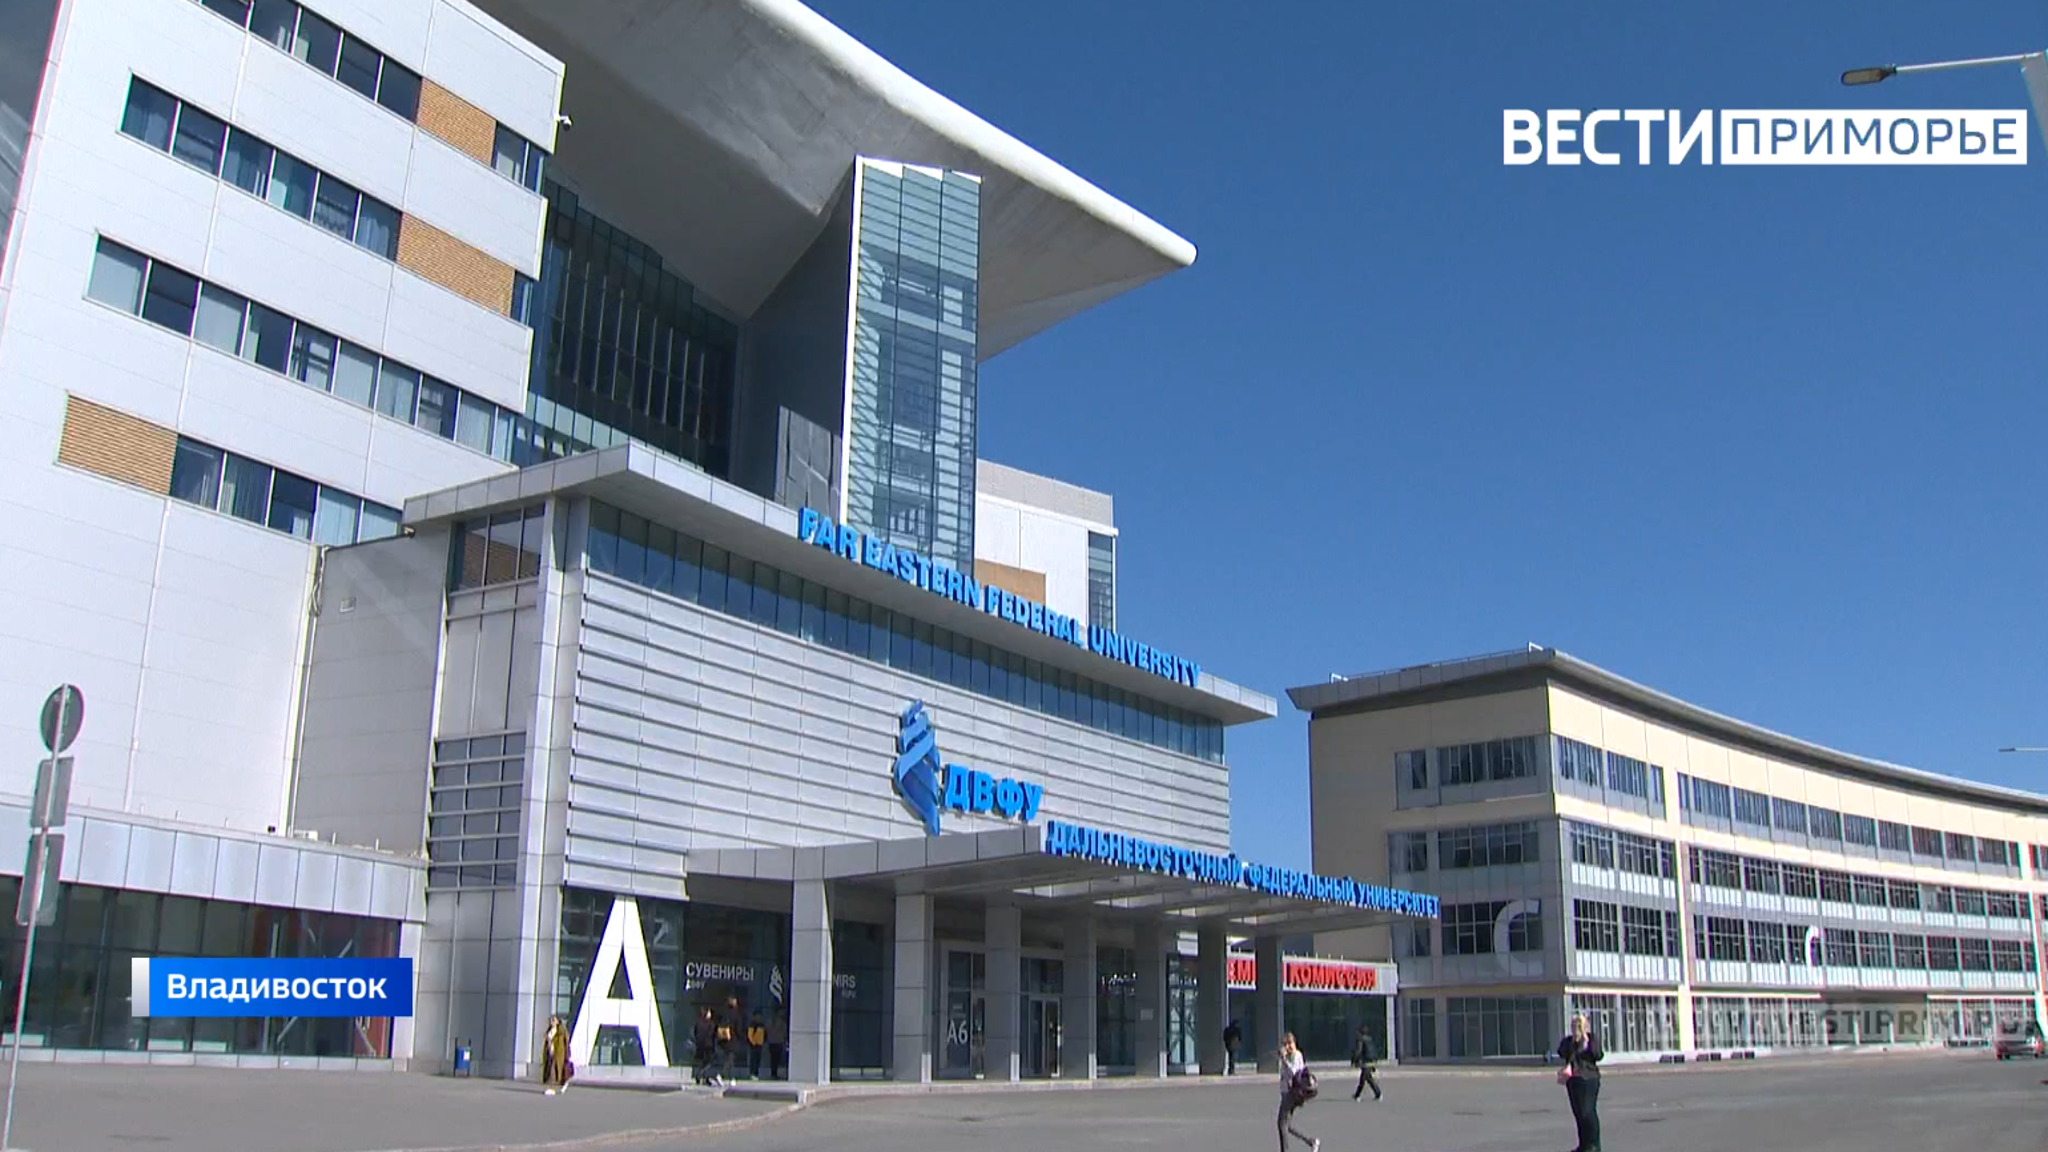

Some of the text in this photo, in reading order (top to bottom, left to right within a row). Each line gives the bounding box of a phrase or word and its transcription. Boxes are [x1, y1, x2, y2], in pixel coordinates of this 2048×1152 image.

[800, 507, 1200, 688] FAR EASTERN FEDERAL UNIVERSITY
[944, 763, 1044, 821] ДВФУ
[1046, 820, 1441, 916] ДАЛЬНЕВОСТОЧНЫЙ ФЕДЕРАЛЬНЫЙ УНИВЕРСИТЕТ
[685, 962, 754, 981] СУВЕНИРЫ
[832, 973, 857, 989] NIRS
[1287, 962, 1377, 991] КОМИССИЯ
